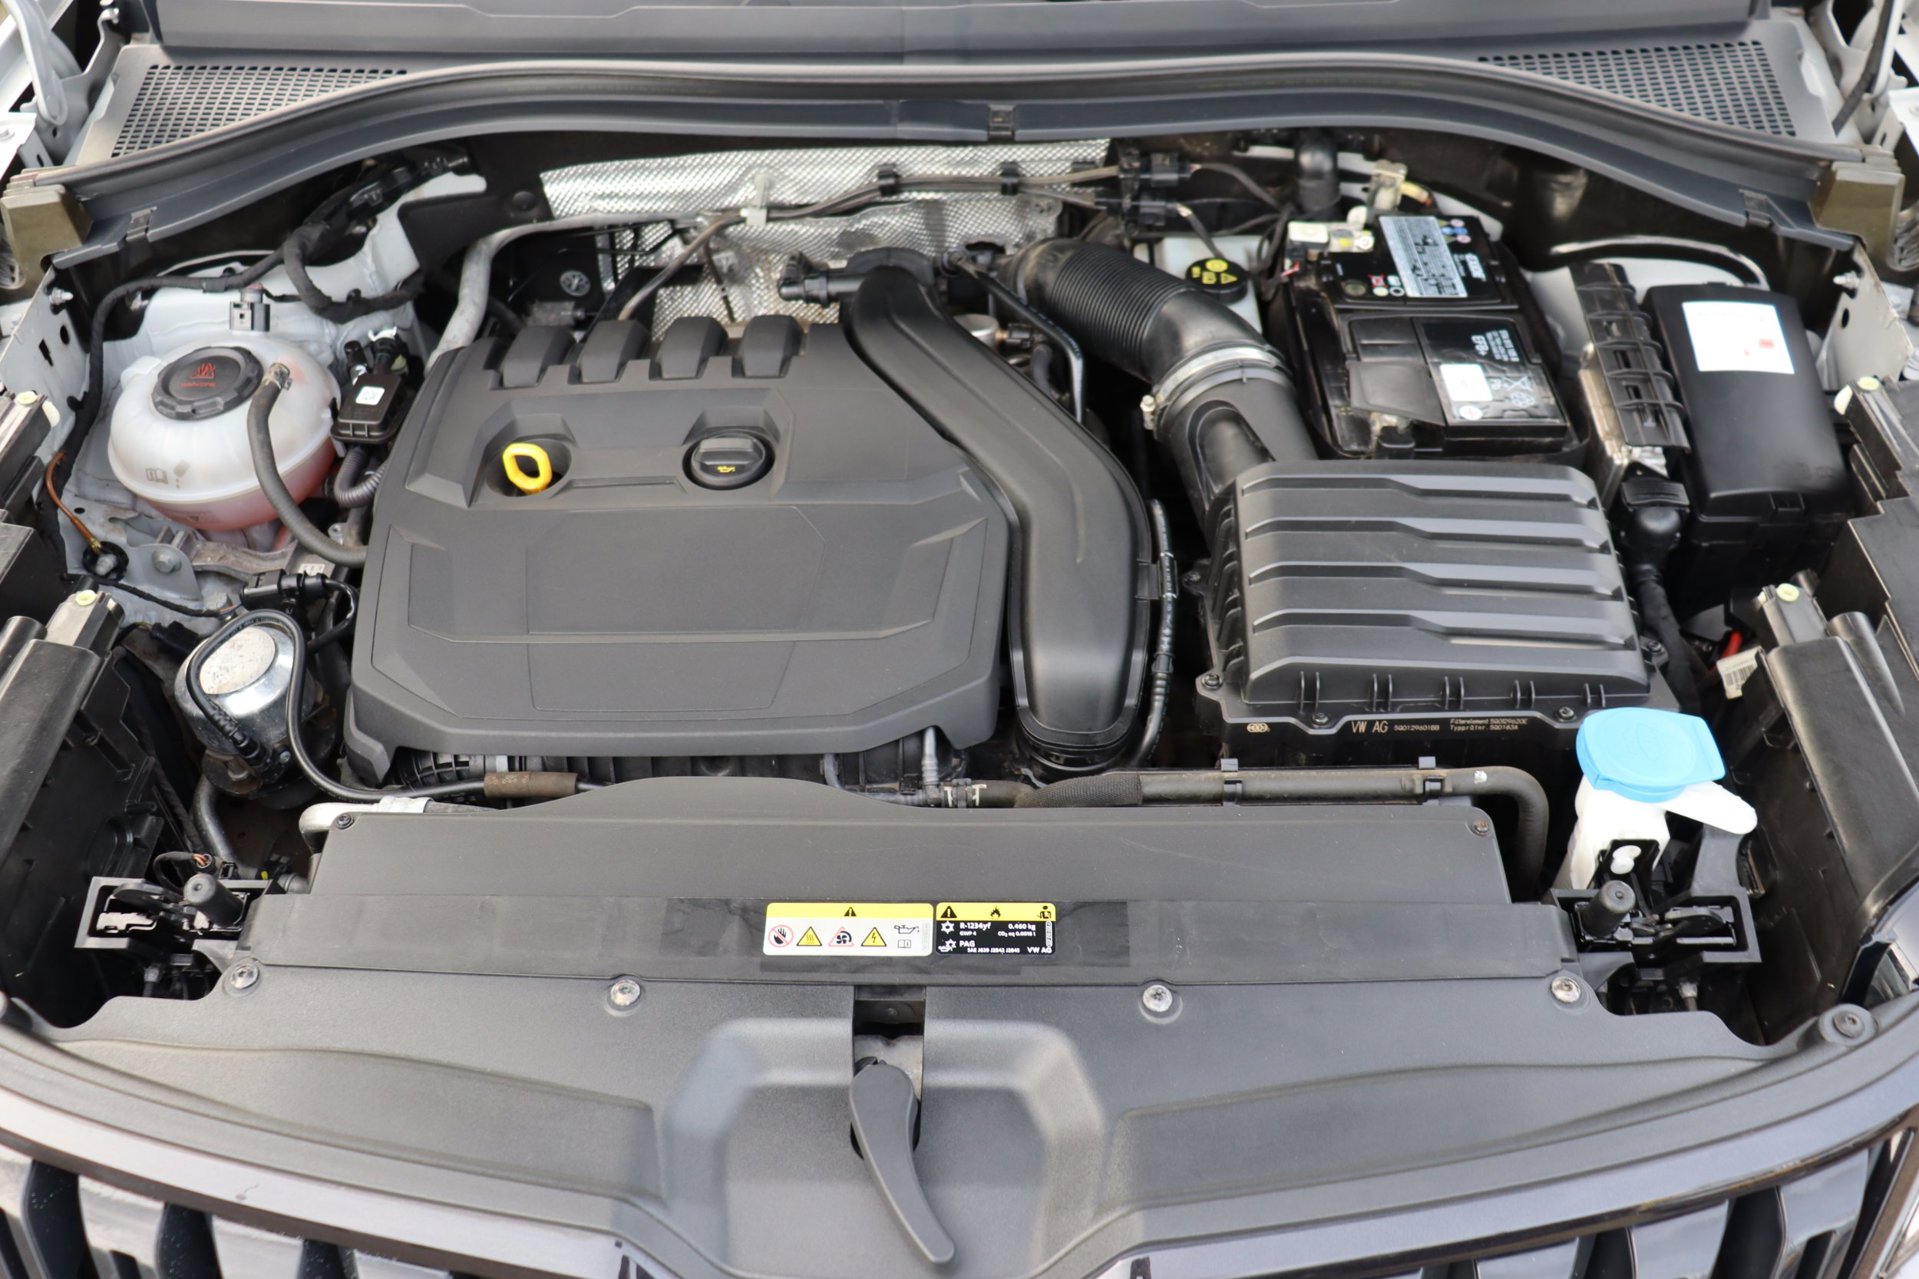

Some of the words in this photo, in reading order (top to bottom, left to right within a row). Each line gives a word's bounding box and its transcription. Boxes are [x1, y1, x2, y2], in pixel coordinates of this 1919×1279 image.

[1351, 720, 1367, 733] VW
[1372, 720, 1388, 733] AG
[959, 922, 992, 931] R-1234yf
[1027, 922, 1036, 931] kg
